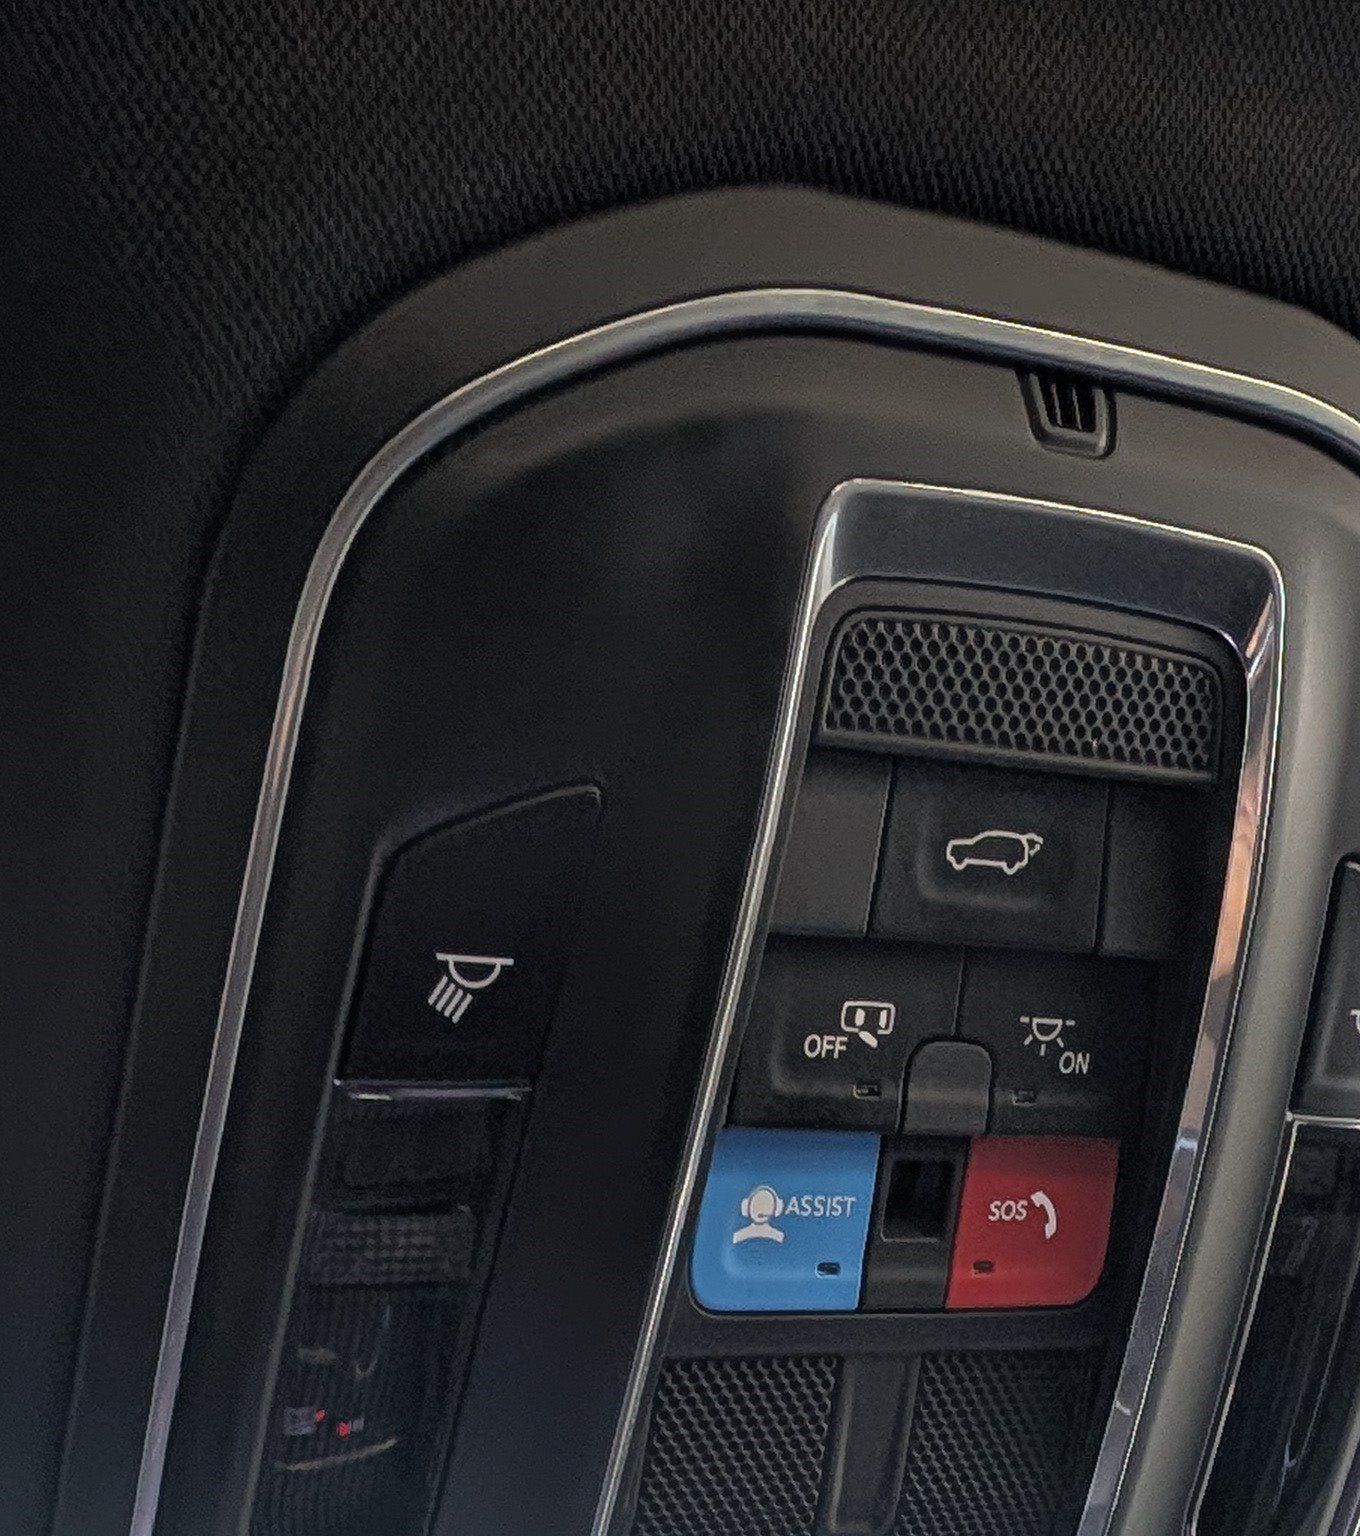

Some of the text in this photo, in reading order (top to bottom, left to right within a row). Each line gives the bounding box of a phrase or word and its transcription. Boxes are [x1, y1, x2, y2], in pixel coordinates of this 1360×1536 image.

[803, 1033, 848, 1060] OFF
[1058, 1050, 1091, 1075] ON
[784, 1195, 857, 1218] ASSIST
[987, 1199, 1029, 1223] SOS
